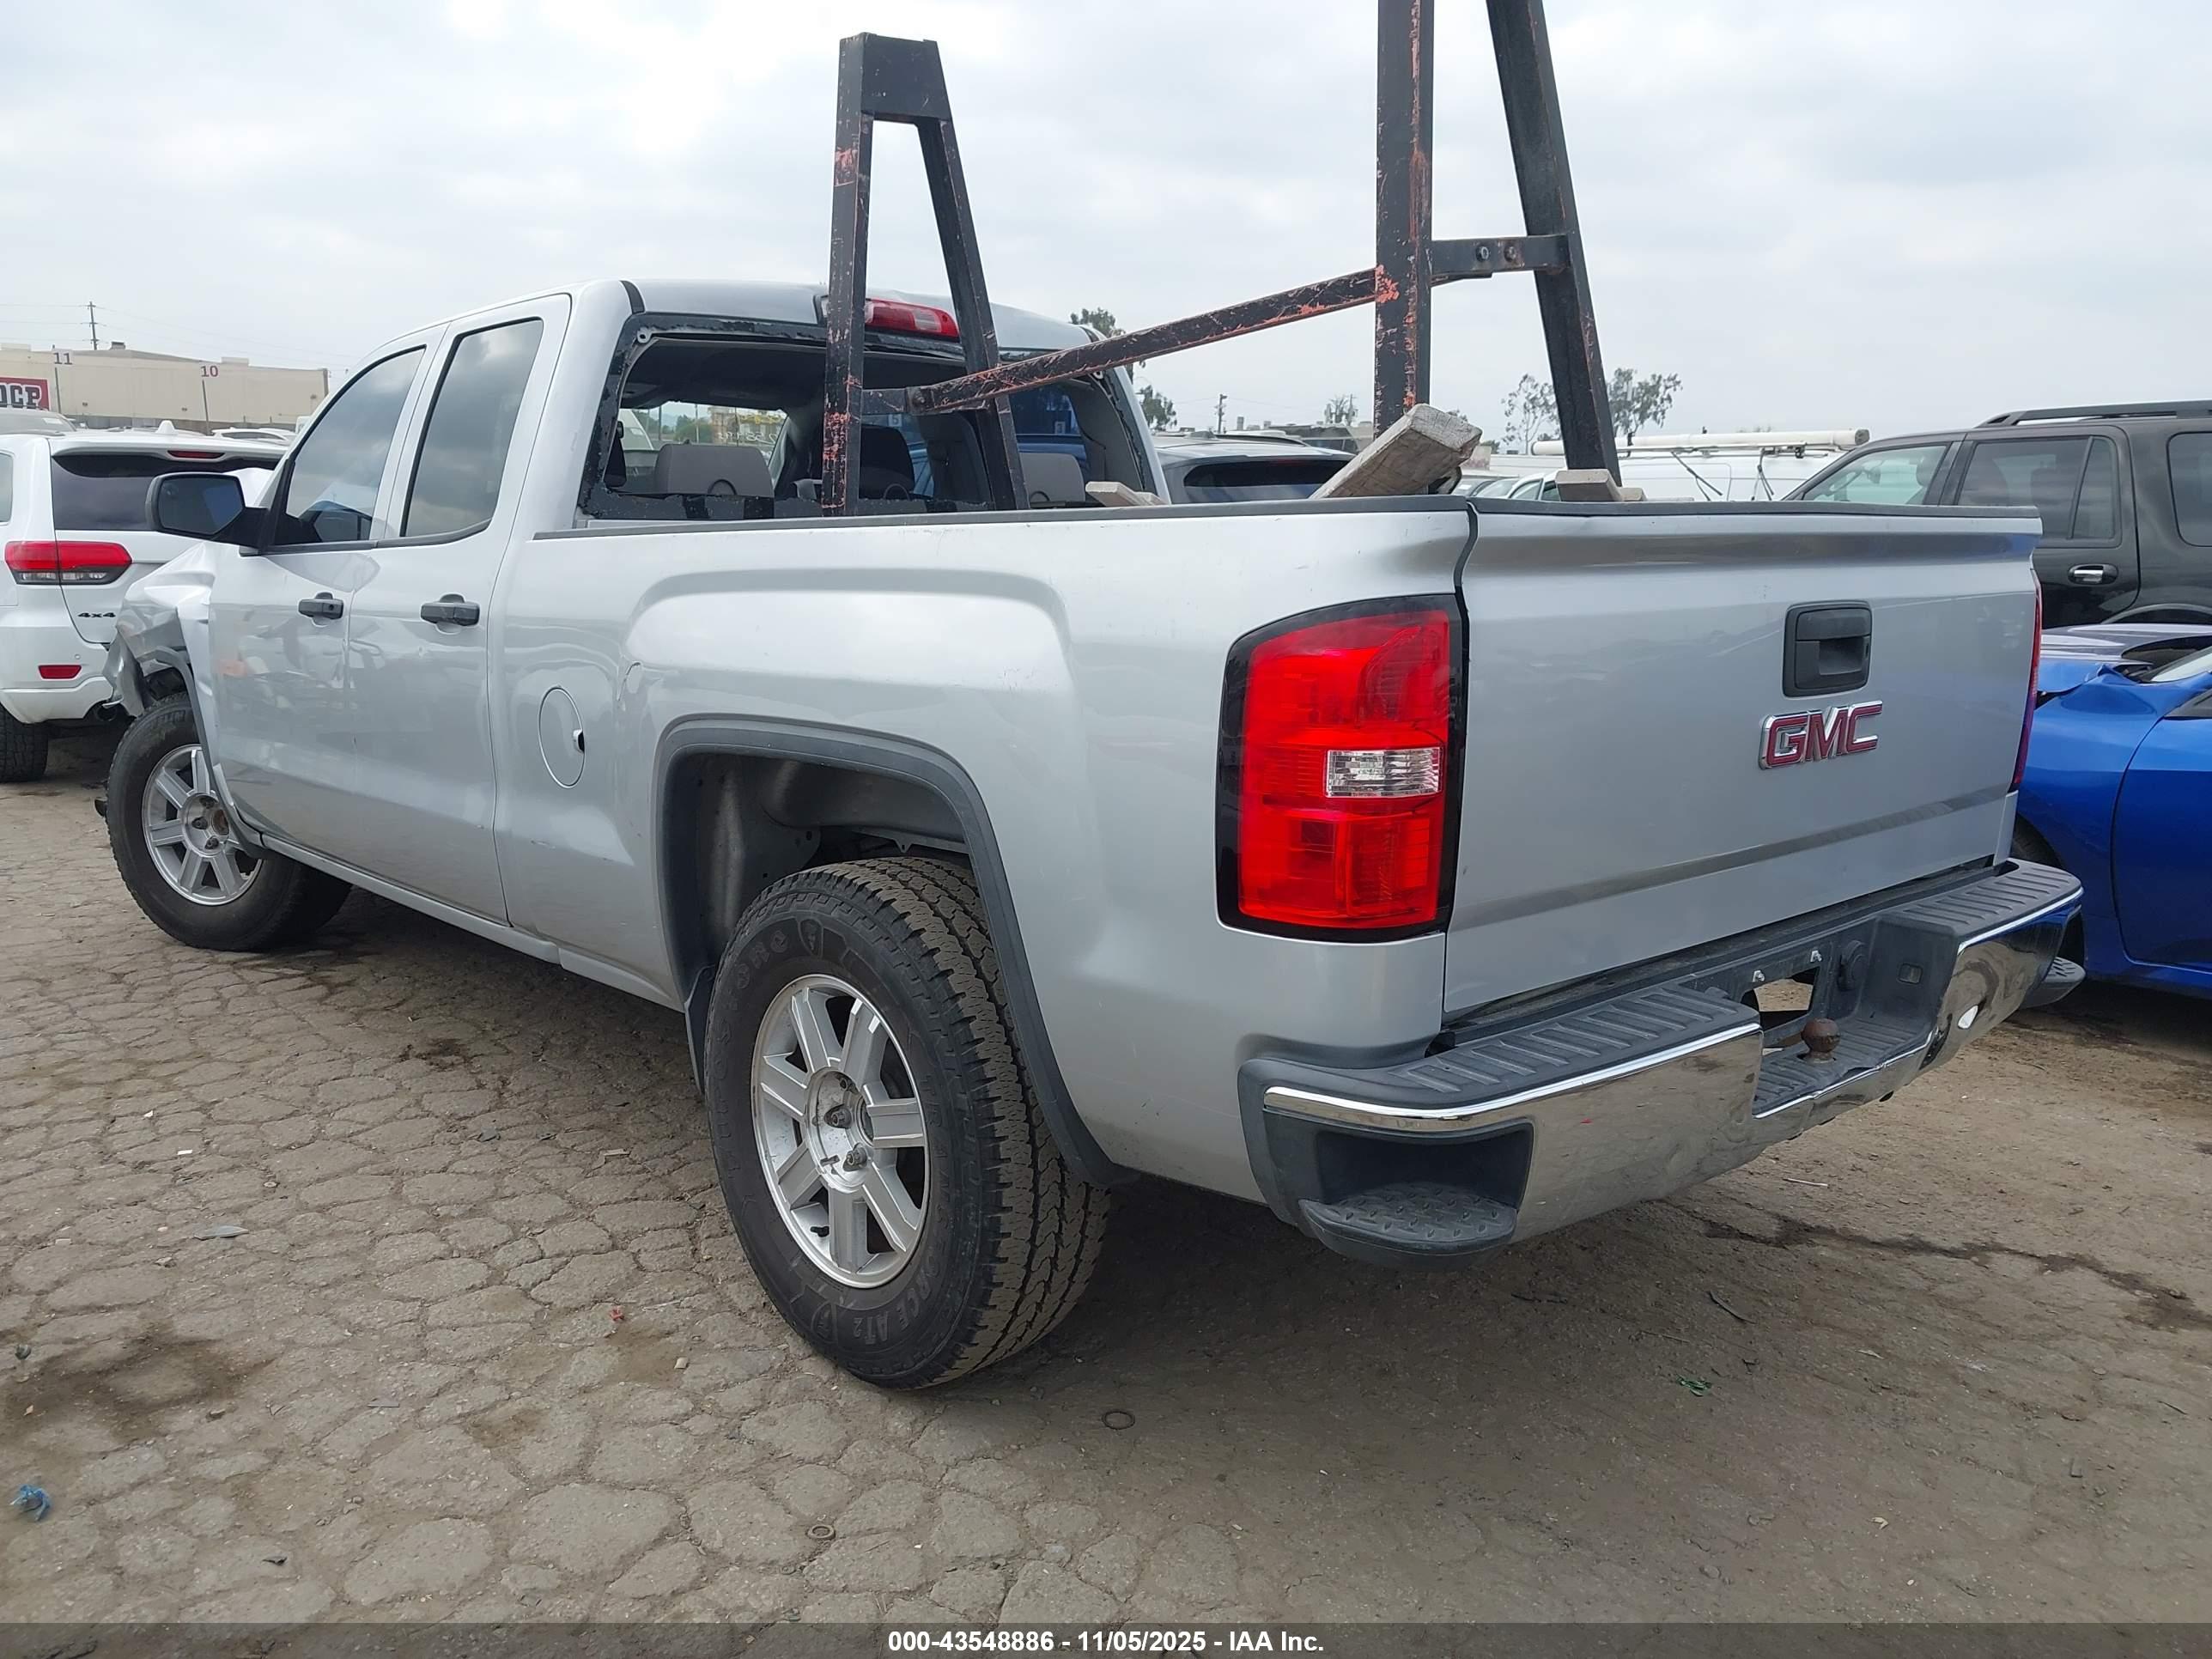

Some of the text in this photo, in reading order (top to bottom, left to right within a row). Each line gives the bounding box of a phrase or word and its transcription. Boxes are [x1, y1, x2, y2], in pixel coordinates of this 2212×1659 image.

[53, 352, 72, 365] 11
[200, 365, 218, 377] 10
[1759, 700, 1882, 770] GMC
